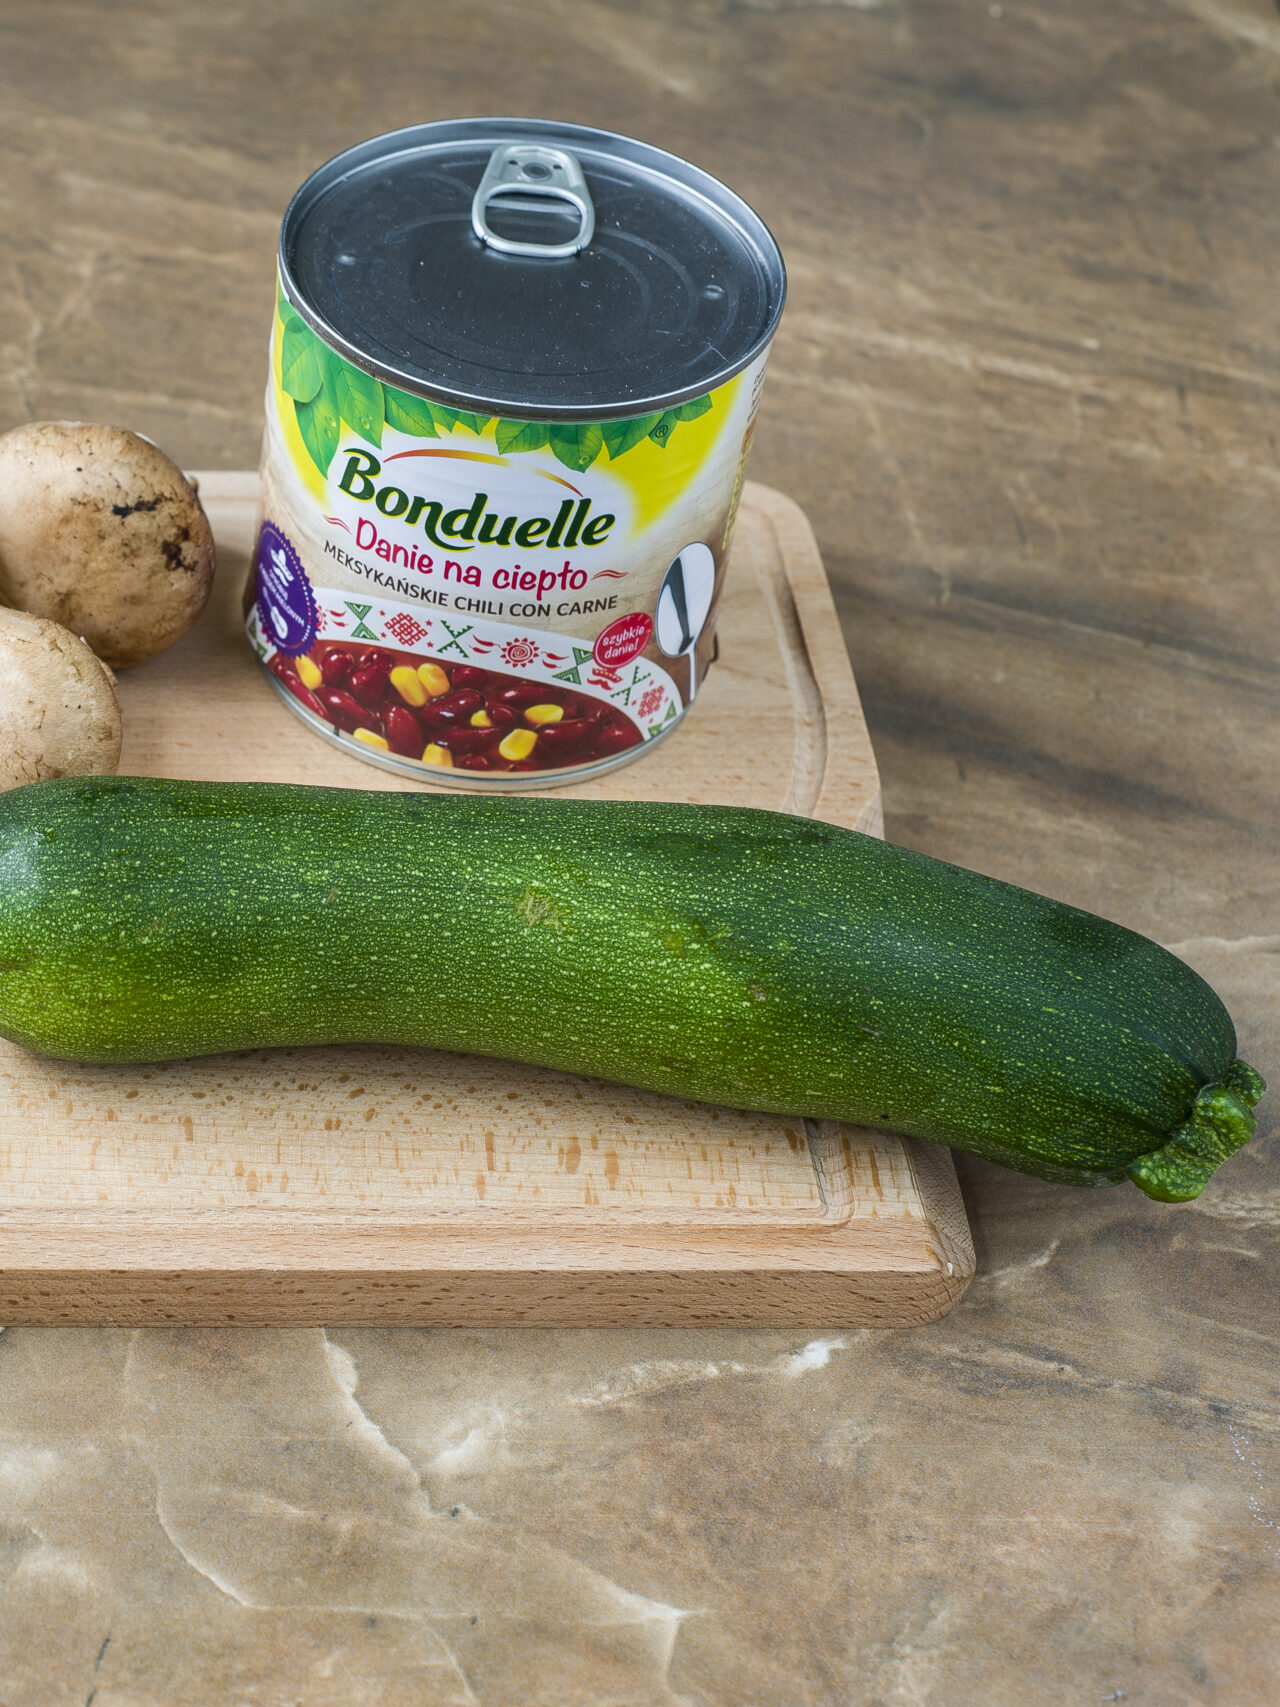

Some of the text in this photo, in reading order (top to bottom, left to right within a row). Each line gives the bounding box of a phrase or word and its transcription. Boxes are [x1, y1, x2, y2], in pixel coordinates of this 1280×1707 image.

[338, 448, 616, 553] Bonduelle
[323, 540, 619, 617] MEKSYKAŃSKIE CHILI CON CARNE
[355, 516, 434, 574] Danie
[443, 560, 482, 587] na
[602, 625, 645, 646] szybkie
[604, 637, 639, 659] danie!
